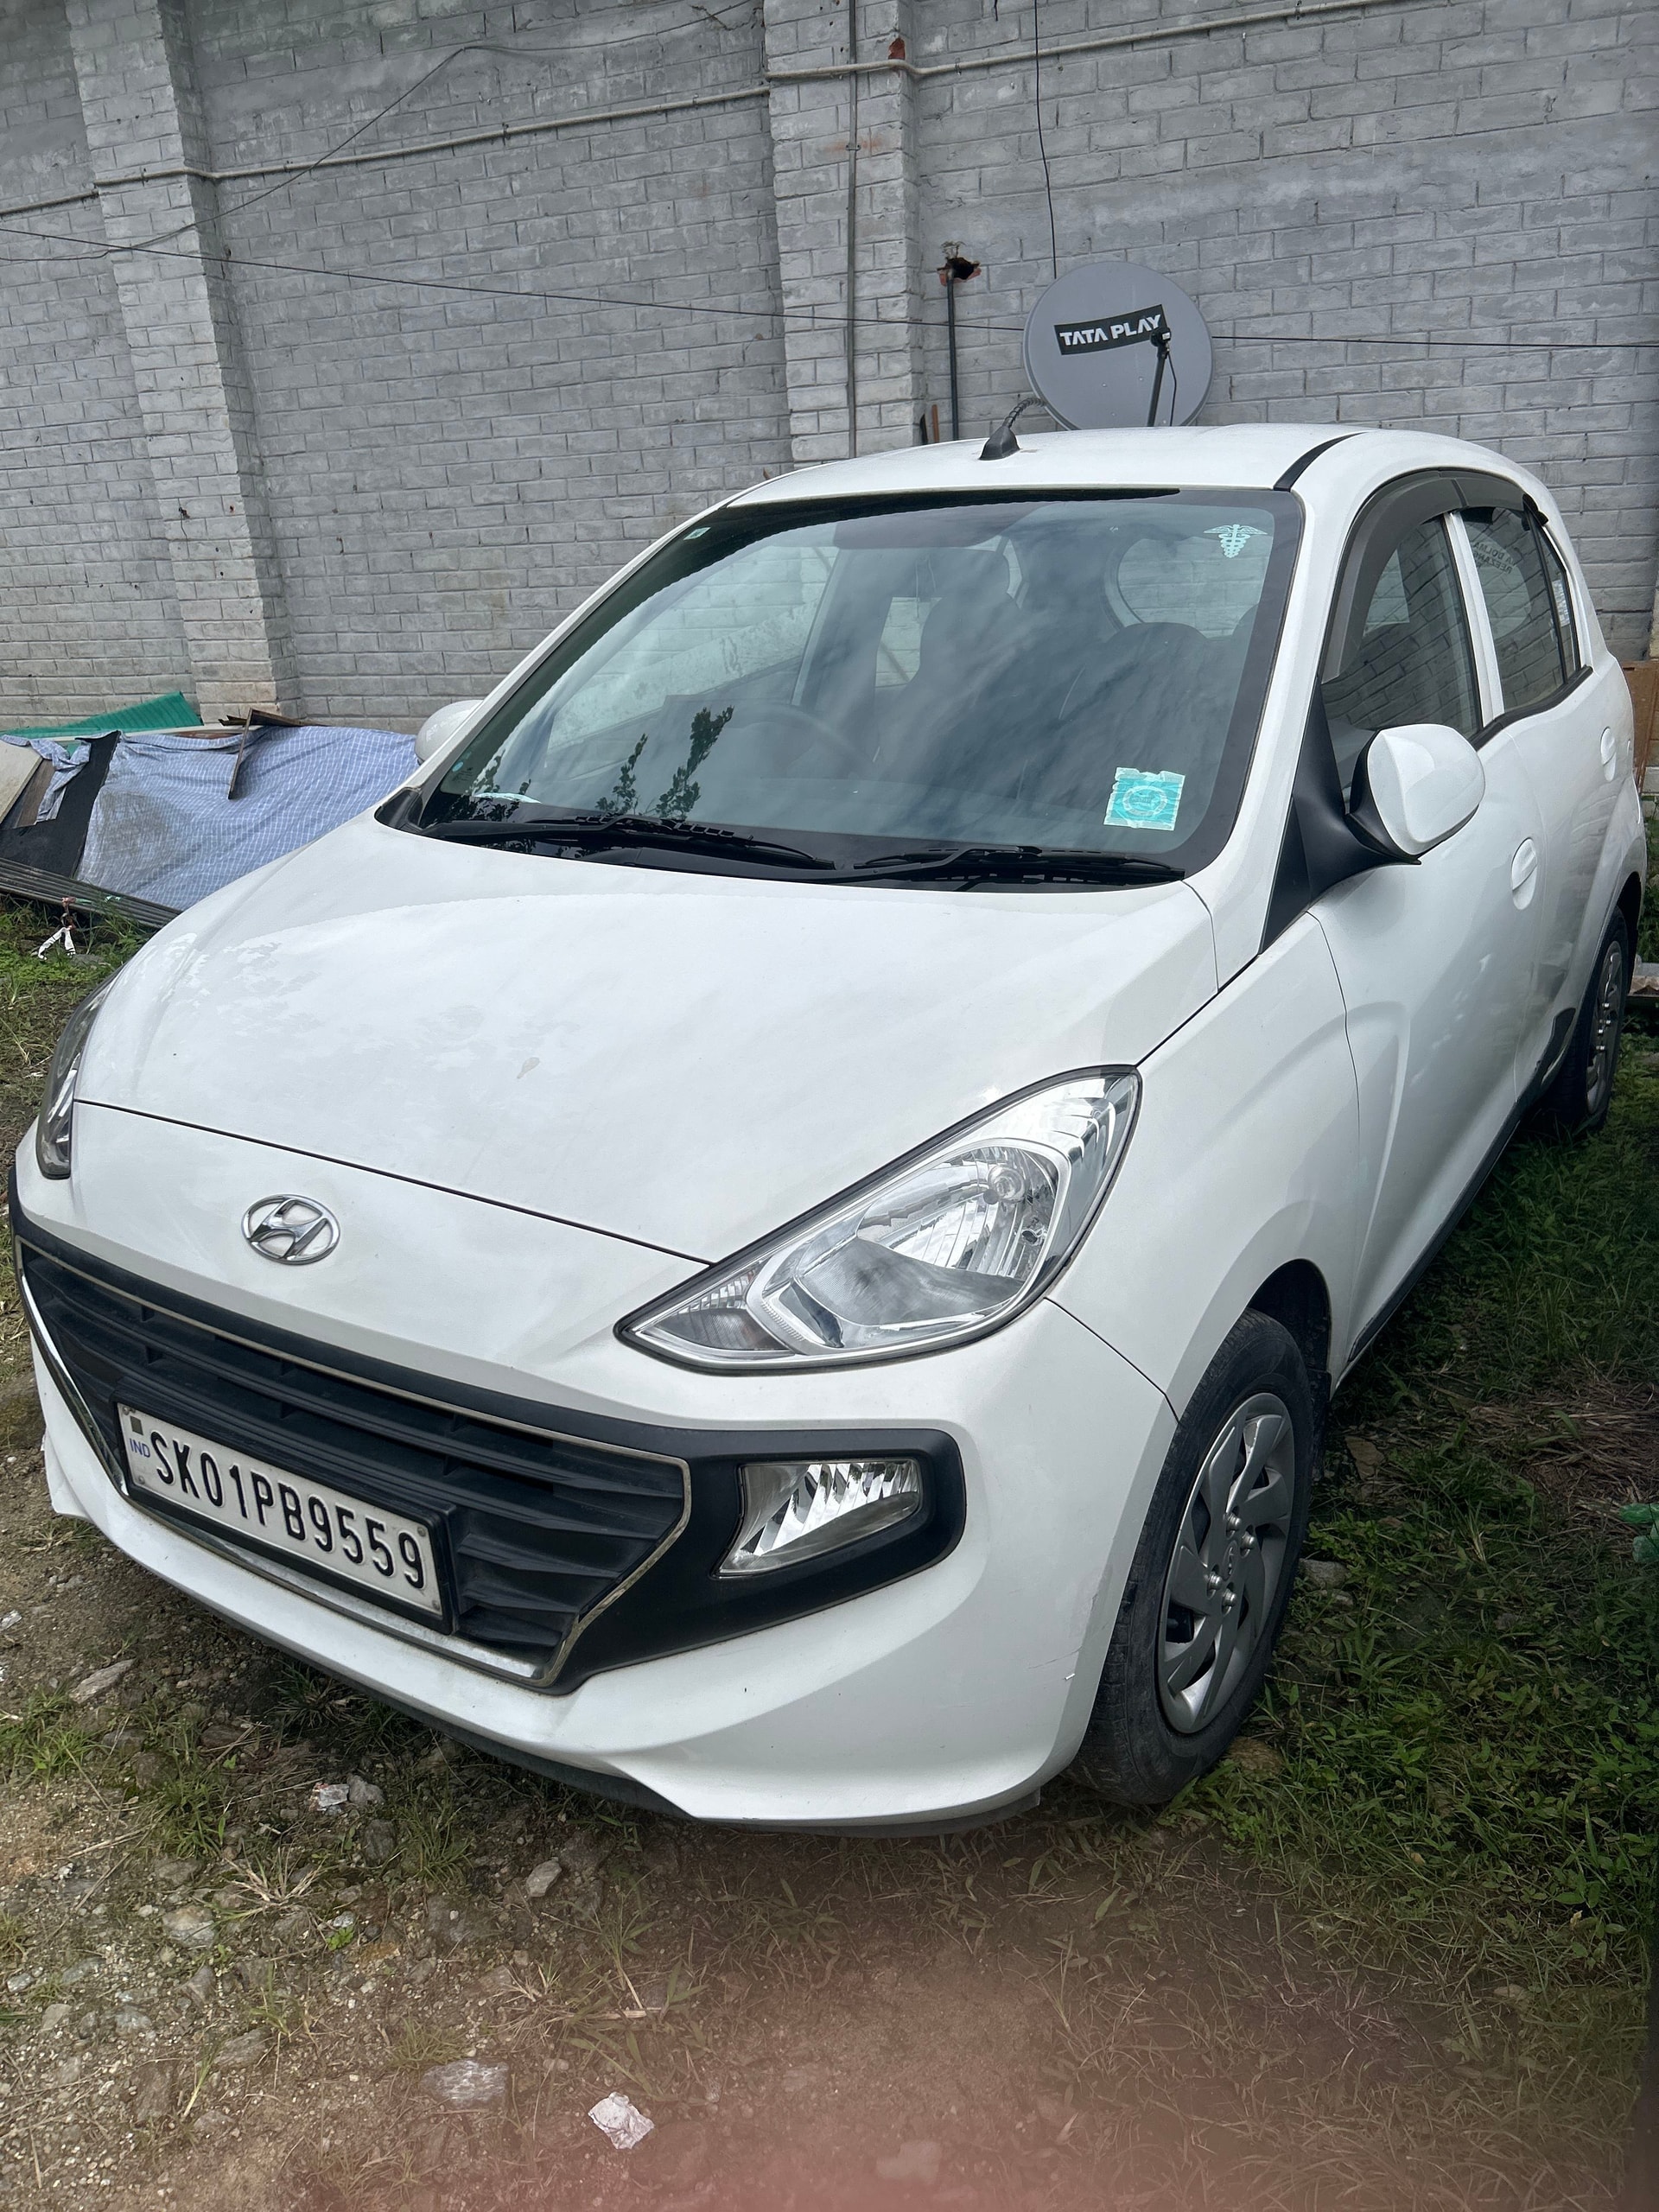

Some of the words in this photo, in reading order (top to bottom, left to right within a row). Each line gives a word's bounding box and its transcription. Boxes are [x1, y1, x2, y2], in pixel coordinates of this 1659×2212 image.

[1059, 327, 1109, 346] TATA
[1110, 314, 1161, 340] PLAY
[130, 1438, 150, 1458] IND
[150, 1431, 425, 1589] SK01PB9559
